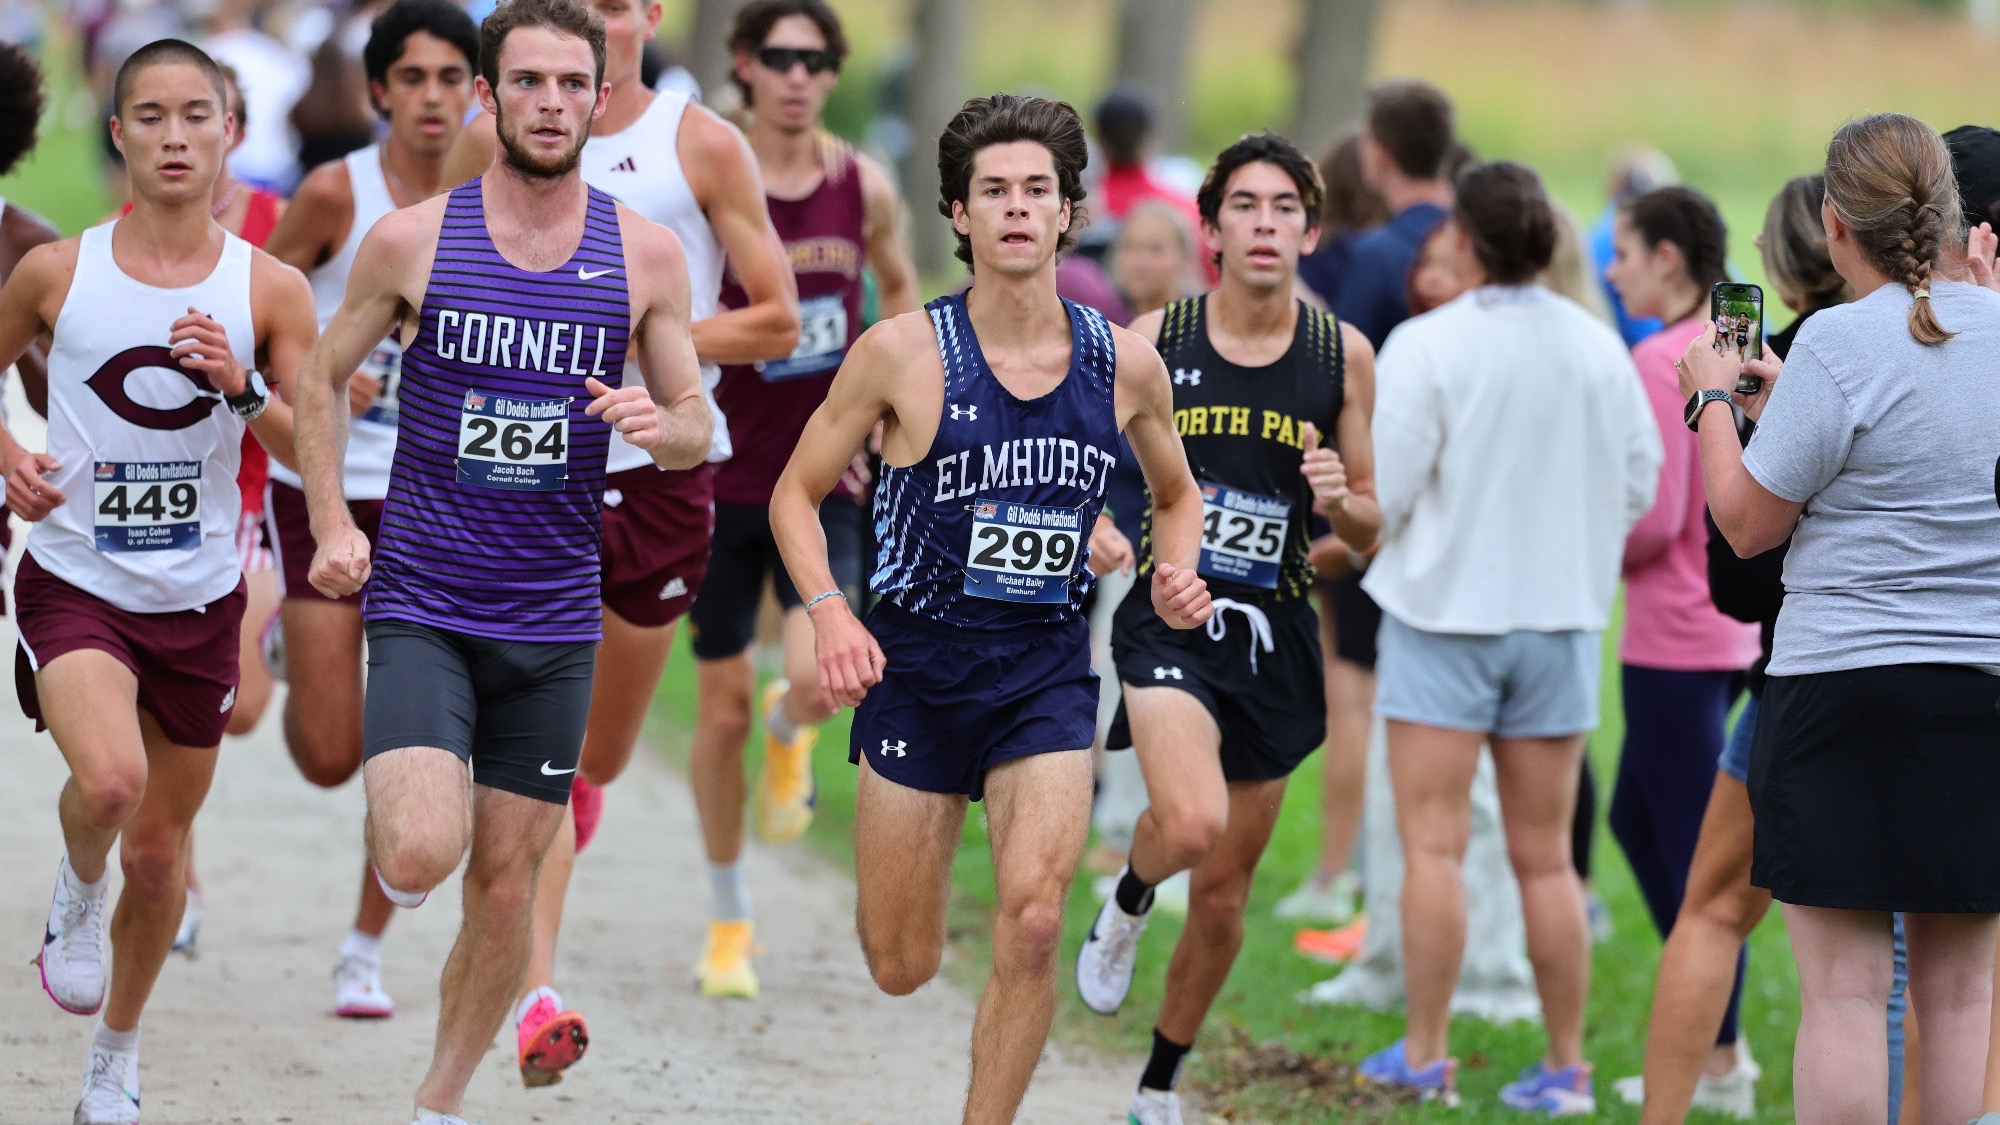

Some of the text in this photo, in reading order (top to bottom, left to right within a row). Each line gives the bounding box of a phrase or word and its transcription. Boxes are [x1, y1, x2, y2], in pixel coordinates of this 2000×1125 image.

[436, 309, 607, 377] CORNELL
[494, 398, 506, 416] Gil
[506, 399, 530, 419] Dodds
[530, 399, 567, 419] Invitational
[463, 417, 566, 461] 264
[1173, 405, 1324, 450] ORTH PA
[125, 463, 135, 480] Gil
[136, 463, 160, 480] Dodds
[160, 461, 199, 479] Invitational
[486, 474, 541, 485] Cornell College
[492, 464, 535, 476] Jacob Bach
[933, 437, 1117, 503] ELMHURST
[98, 483, 198, 522] 449
[1007, 505, 1018, 523] Gil
[1018, 507, 1041, 526] Dodds
[1041, 509, 1079, 529] Invitational
[127, 527, 171, 538] Isaac Cohen
[1202, 510, 1283, 557] 425
[972, 526, 1075, 573] 299
[996, 574, 1046, 590] Michael Bailey
[1006, 586, 1037, 596] Elmhurst
